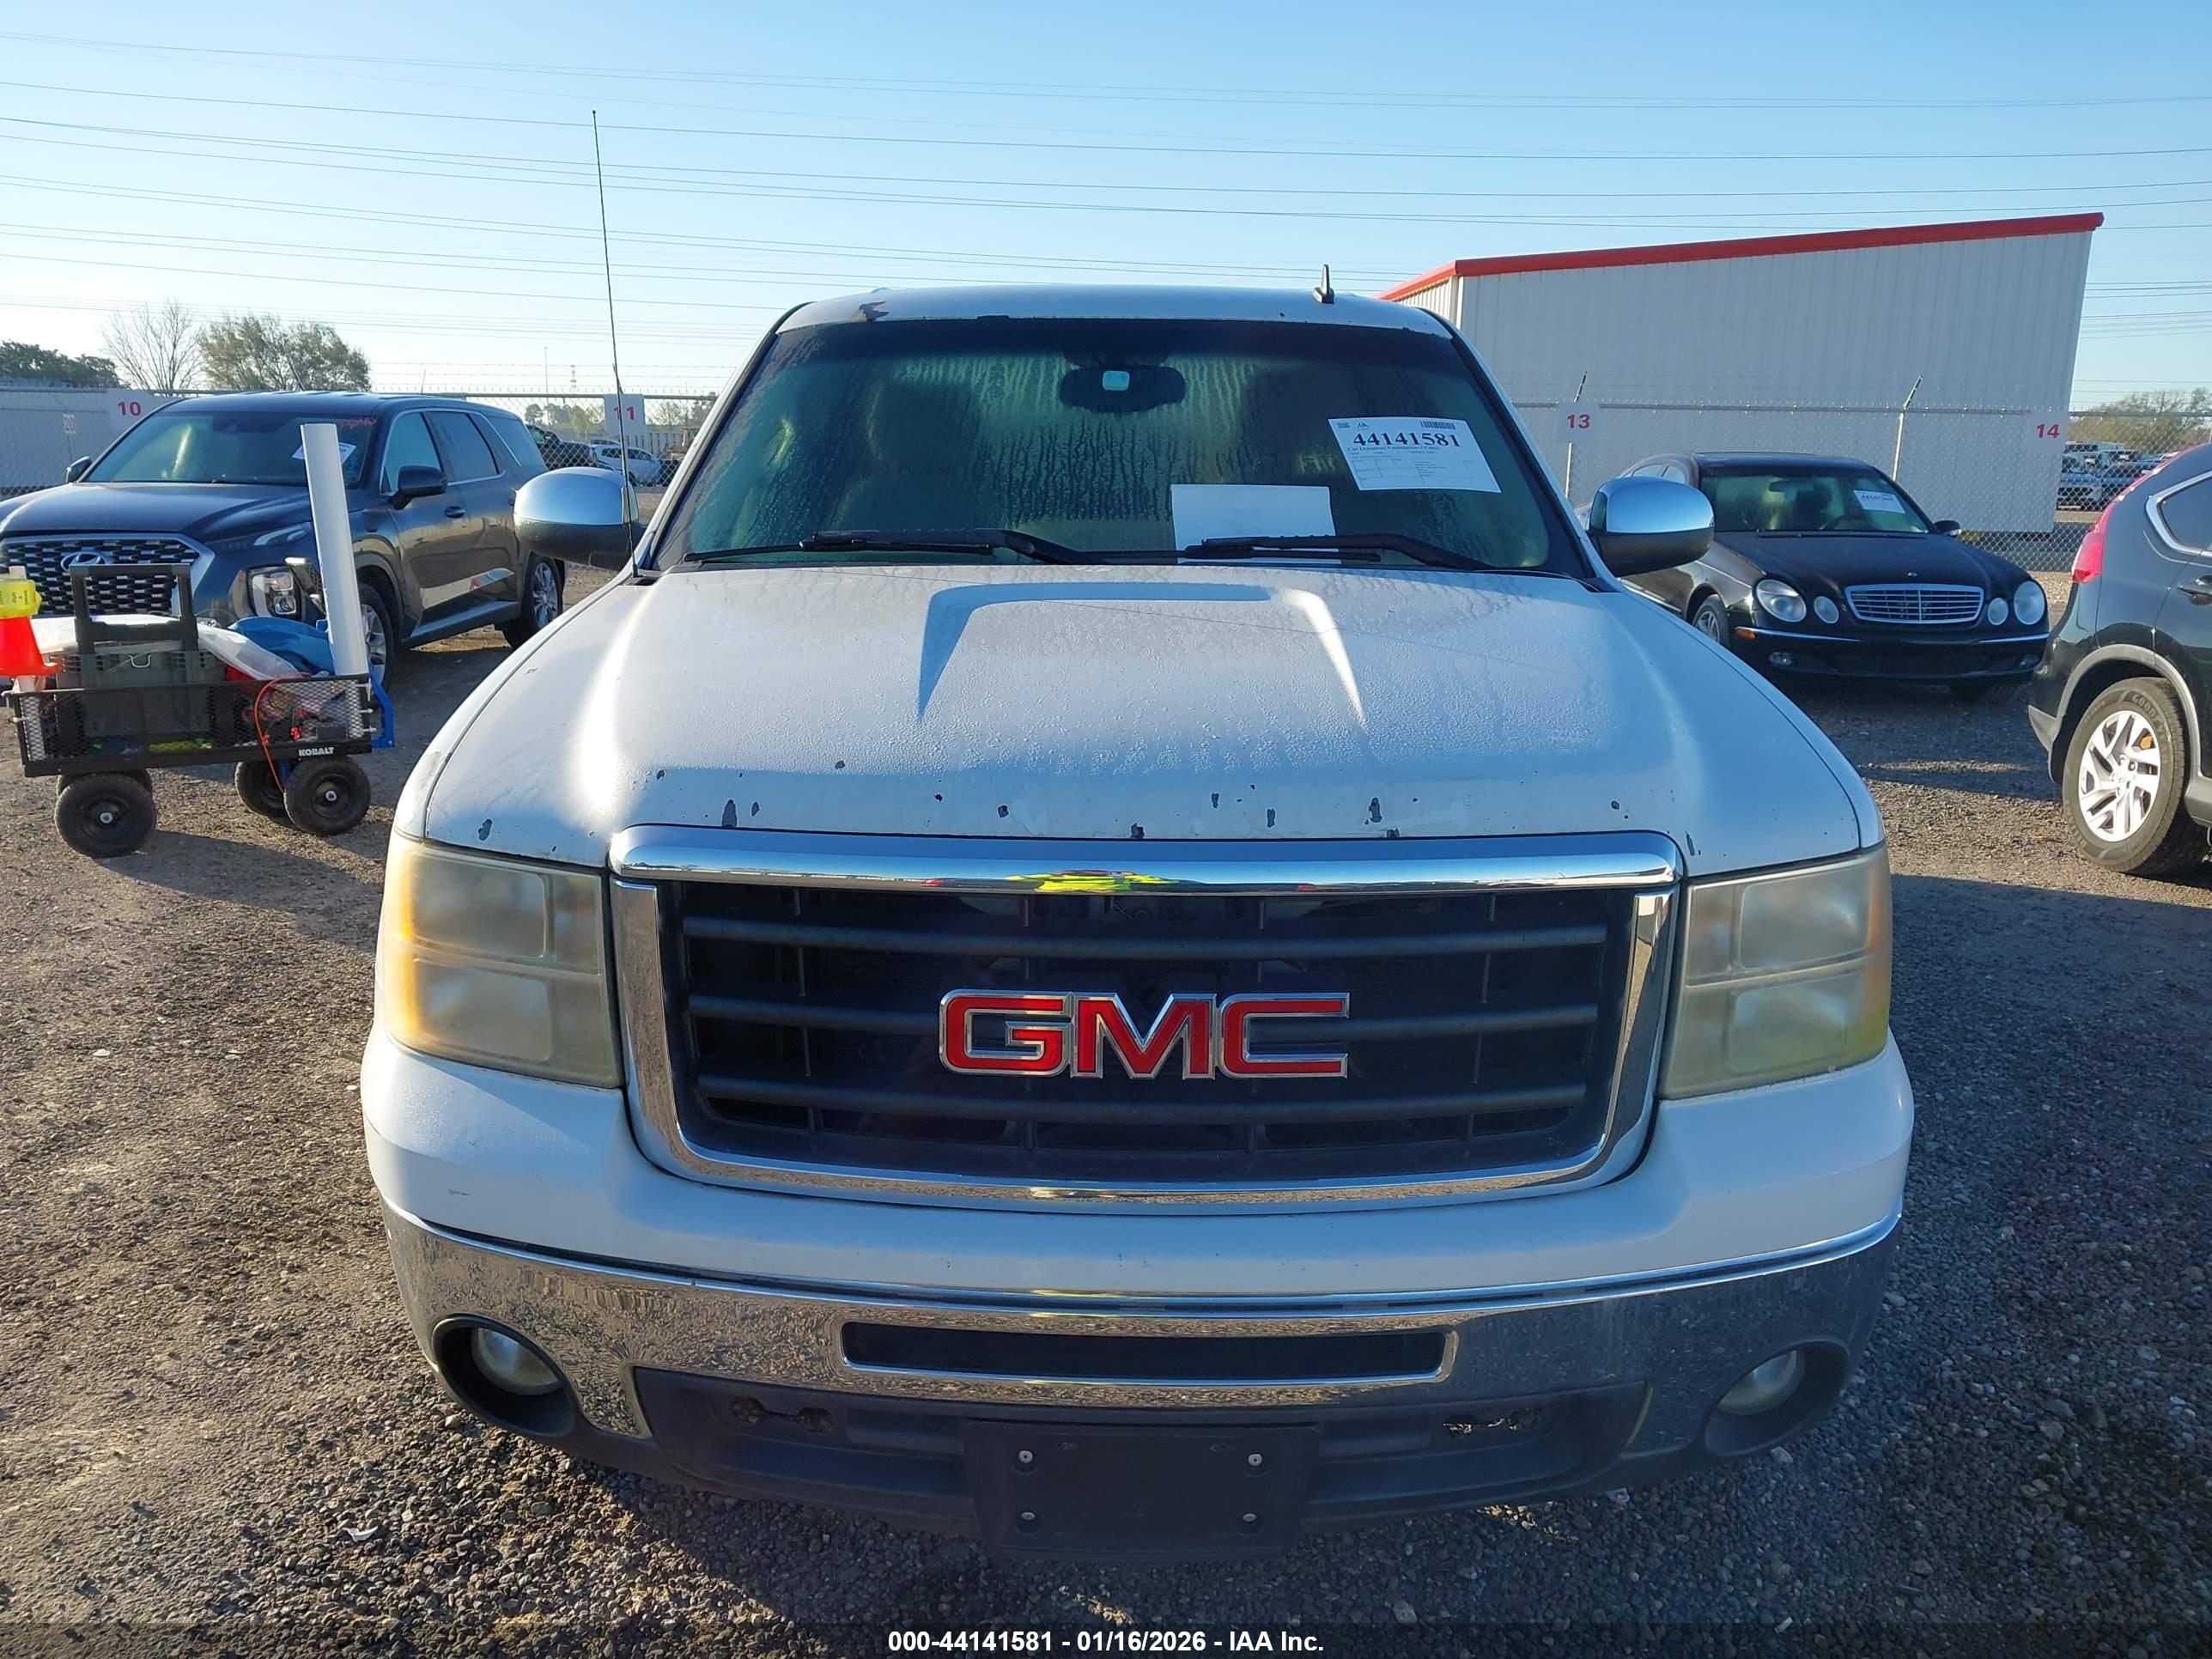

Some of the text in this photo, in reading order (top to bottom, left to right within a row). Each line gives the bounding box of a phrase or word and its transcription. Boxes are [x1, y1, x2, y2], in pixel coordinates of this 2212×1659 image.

[118, 401, 142, 416] 10
[613, 405, 635, 420] 11
[1567, 414, 1590, 428] 13
[2037, 423, 2060, 438] 14
[1353, 432, 1462, 447] 44141581
[298, 746, 335, 757] KOBALT
[939, 988, 1351, 1080] GMC
